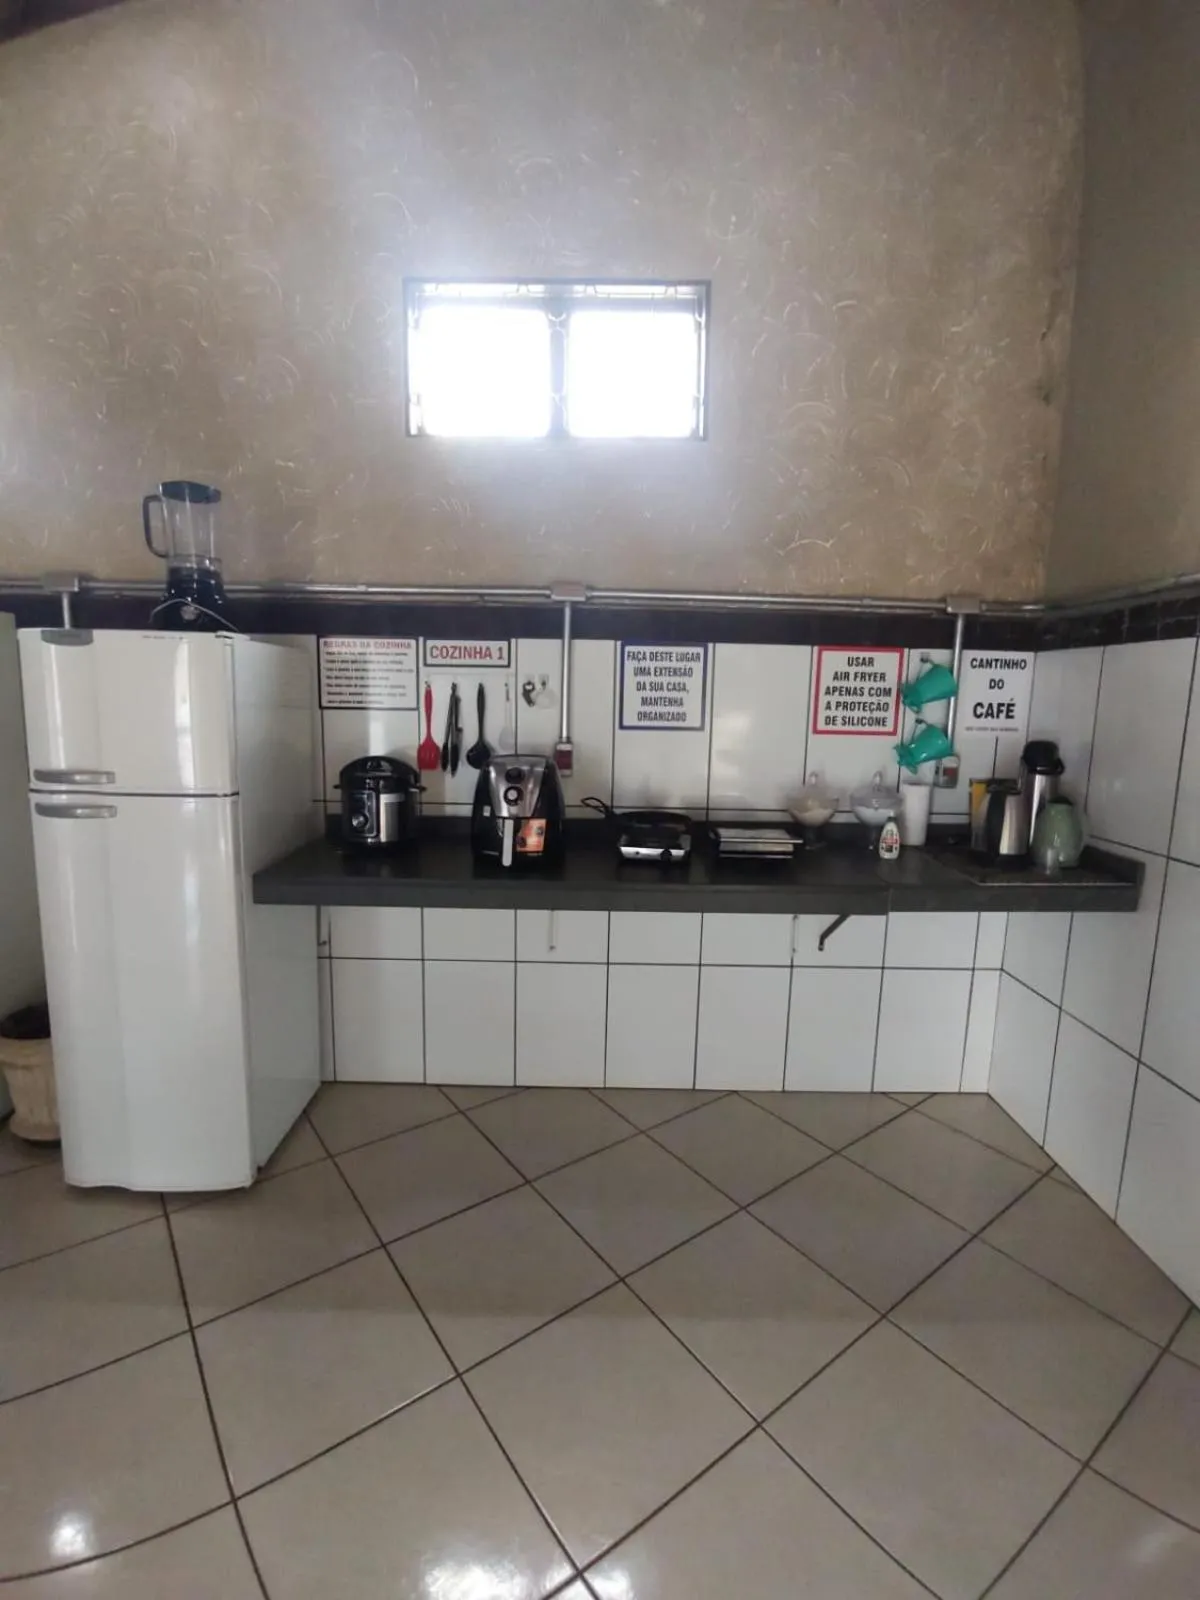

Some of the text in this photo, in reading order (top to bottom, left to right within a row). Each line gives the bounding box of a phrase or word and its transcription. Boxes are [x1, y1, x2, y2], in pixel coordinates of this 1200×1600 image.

[430, 645, 505, 660] COZINHA 1
[627, 651, 701, 664] FAÇA DESTE LUGAR
[847, 656, 875, 667] USAR
[970, 657, 1028, 670] CANTINHO
[633, 665, 693, 678] UMA EXTENSÃO
[832, 671, 886, 682] AIR FRYER
[636, 681, 690, 694] DA SUA CASA,
[988, 678, 1005, 690] DO
[824, 686, 892, 697] APENAS COM
[640, 697, 684, 707] MANTENHA
[824, 699, 889, 714] A PROTEÇÃO
[973, 697, 1016, 720] CAFÉ
[637, 711, 687, 722] ORGANIZADO
[824, 716, 888, 727] DE SILICONE
